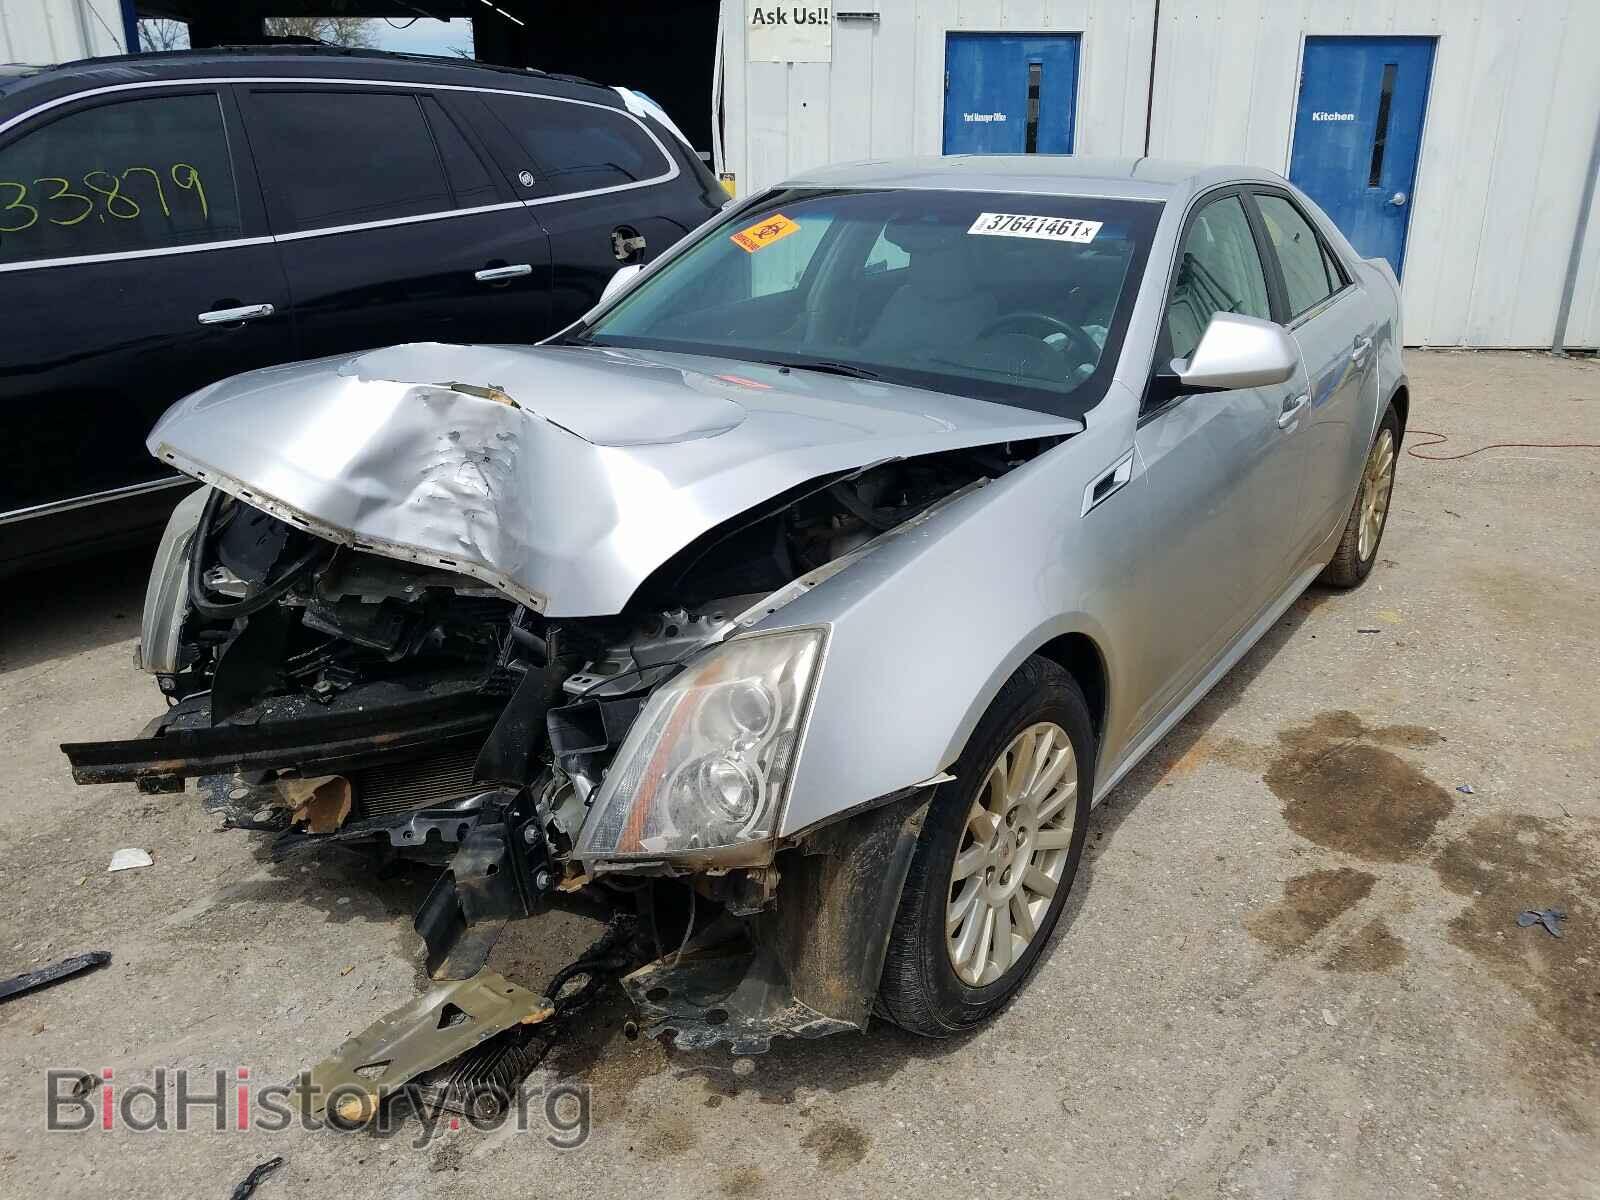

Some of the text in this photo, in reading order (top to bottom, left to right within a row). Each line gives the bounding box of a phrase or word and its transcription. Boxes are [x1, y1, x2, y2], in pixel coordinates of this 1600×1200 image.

[752, 7, 829, 25] Ask Us!!
[1312, 111, 1355, 121] Kitchen
